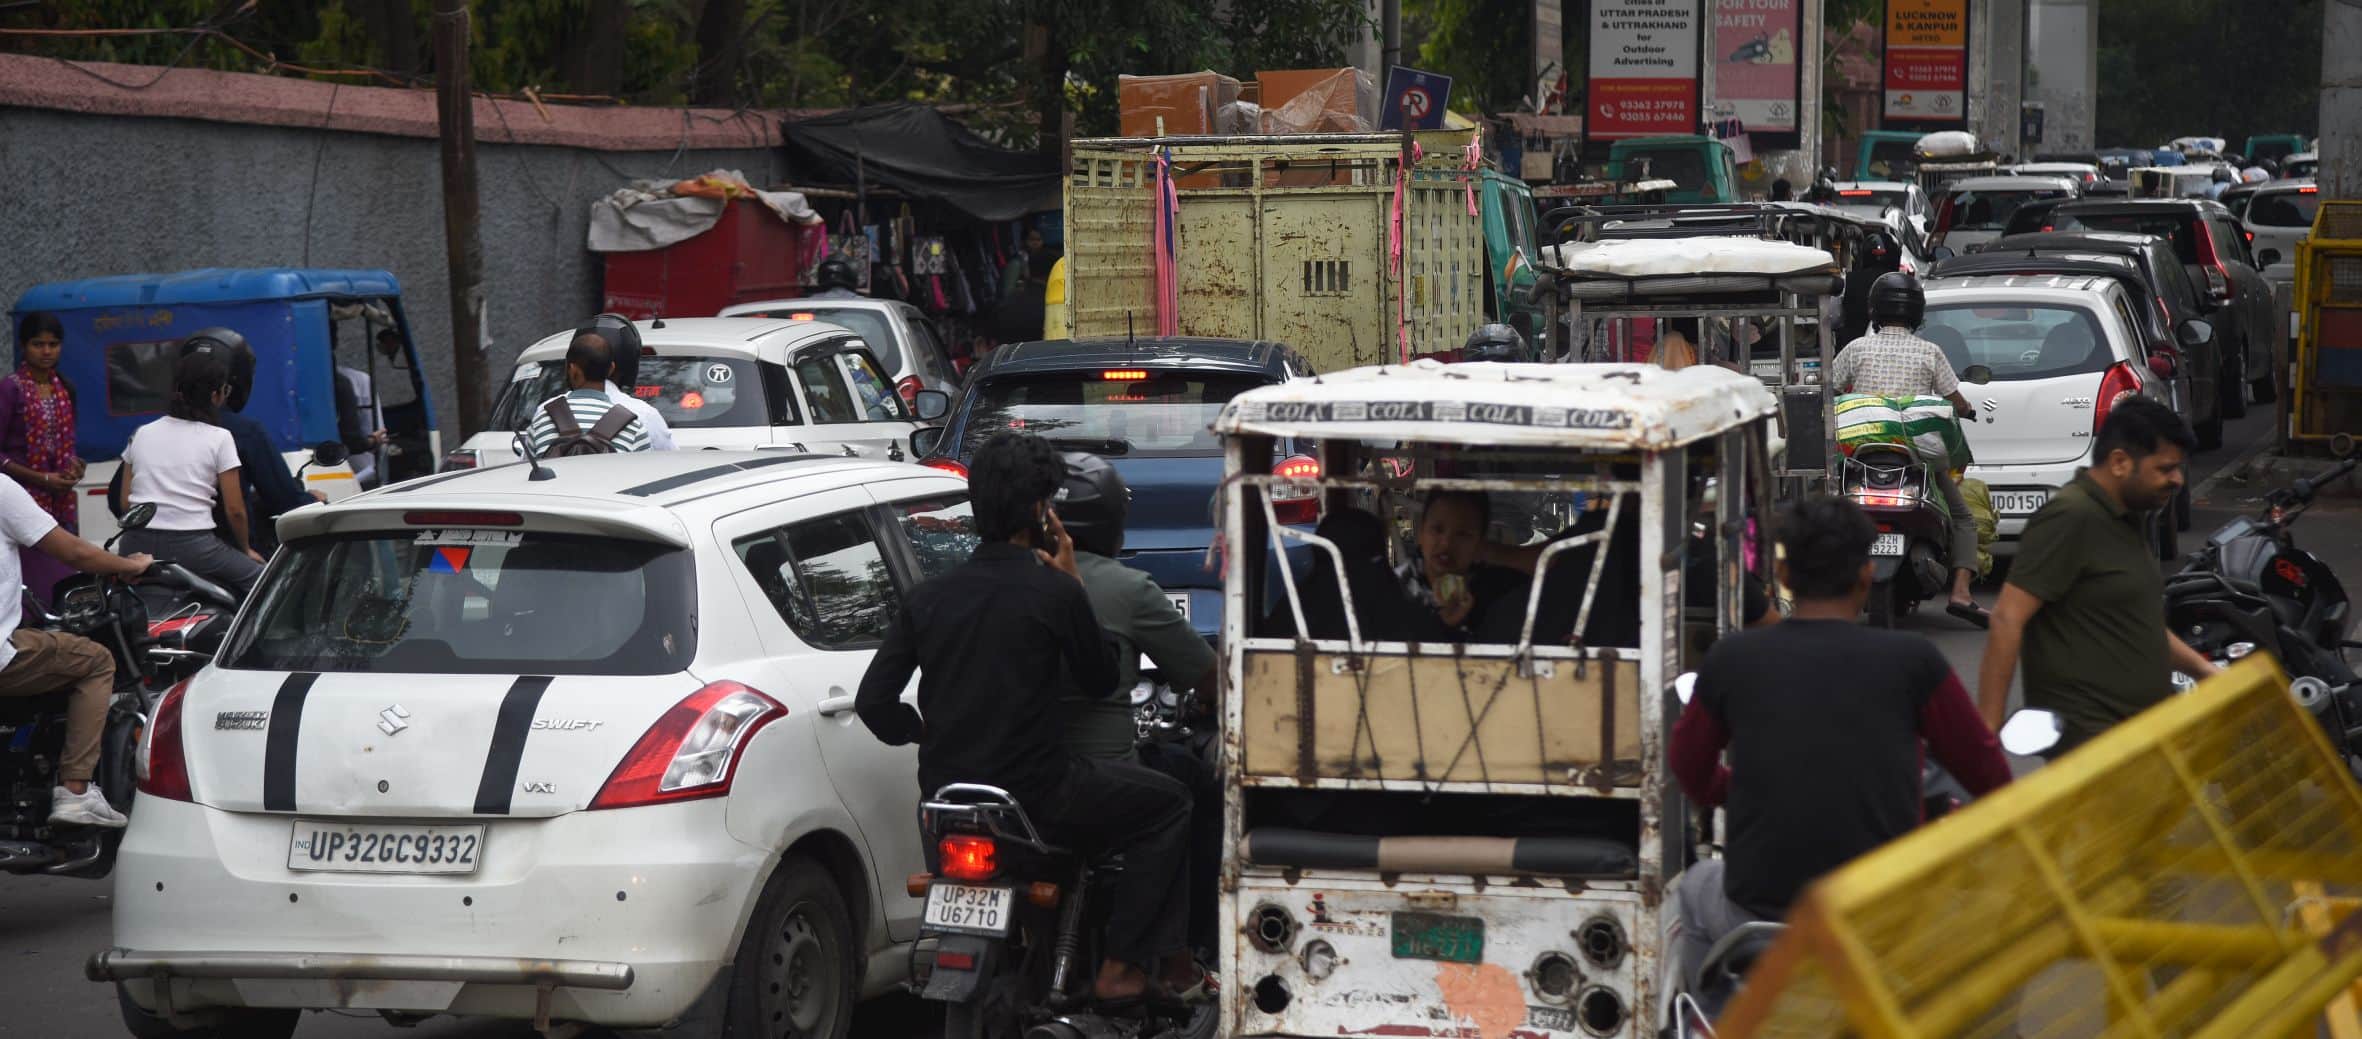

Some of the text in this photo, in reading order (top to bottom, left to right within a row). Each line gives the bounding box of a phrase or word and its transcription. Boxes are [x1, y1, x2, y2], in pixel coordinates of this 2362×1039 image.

[1748, 0, 1789, 9] YOUR
[1600, 9, 1690, 18] UTTAR PRADESH
[1896, 11, 1957, 20] LUCKNOW
[1612, 21, 1688, 30] UTTRAKHAND
[1716, 14, 1765, 27] SAFETY
[1907, 22, 1958, 31] KANPUR
[1637, 33, 1652, 41] for
[1623, 44, 1667, 54] Outdoor
[1614, 57, 1675, 67] Advertising
[1269, 403, 1324, 420] COLA
[1368, 402, 1426, 419] COLA
[1467, 403, 1525, 424] COLA
[1568, 409, 1632, 428] COLA
[1873, 544, 1898, 554] 9223
[214, 719, 266, 730] SUZUKI
[531, 718, 603, 732] SWIFT
[294, 831, 476, 864] IND UP32GC9332
[940, 905, 998, 927] U6710
